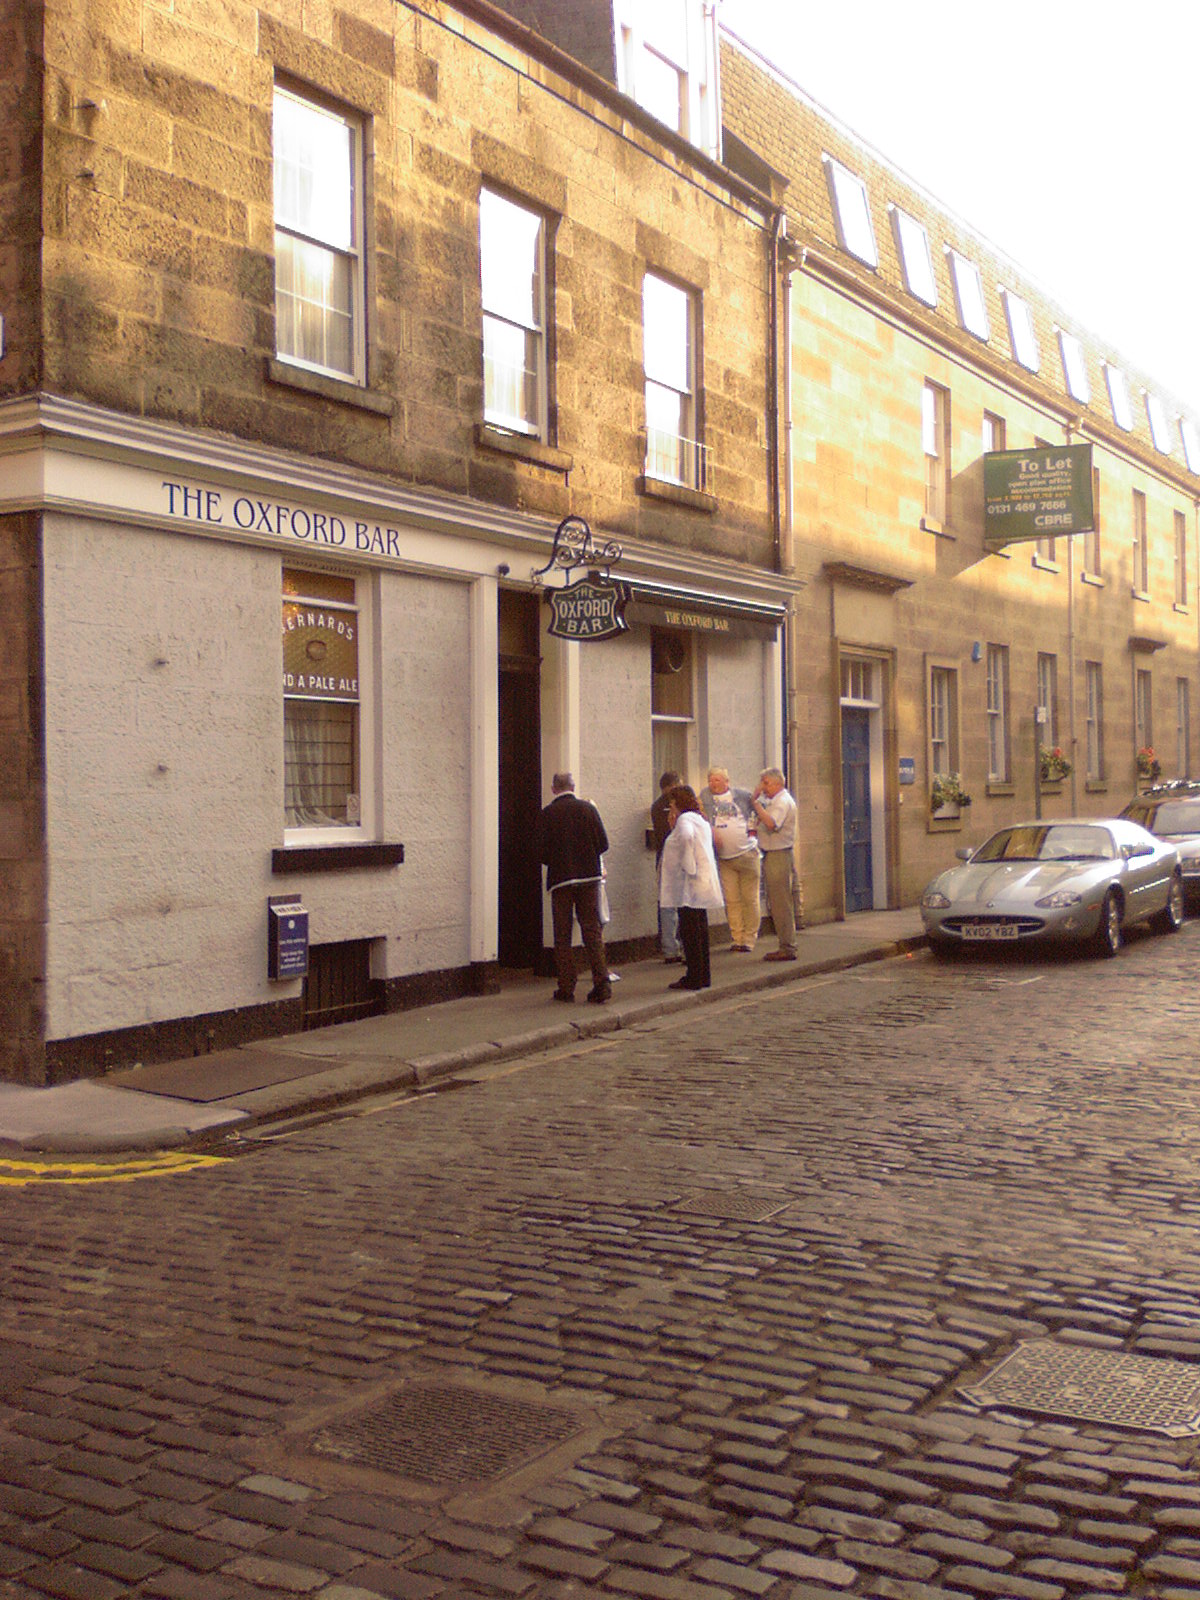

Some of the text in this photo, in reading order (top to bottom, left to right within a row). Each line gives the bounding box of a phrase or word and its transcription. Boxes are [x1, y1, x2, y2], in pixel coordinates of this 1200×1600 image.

[1018, 457, 1073, 473] To Let
[987, 504, 1011, 515] 0131
[1015, 502, 1036, 513] 469
[162, 481, 401, 557] THE OXFORD BAR
[1034, 512, 1073, 527] CBRE
[559, 587, 611, 634] THE OXFORD BAR
[664, 610, 730, 632] THE OXFORD BAR
[309, 675, 335, 690] PALE
[338, 678, 357, 692] ALE
[965, 927, 991, 937] KV02
